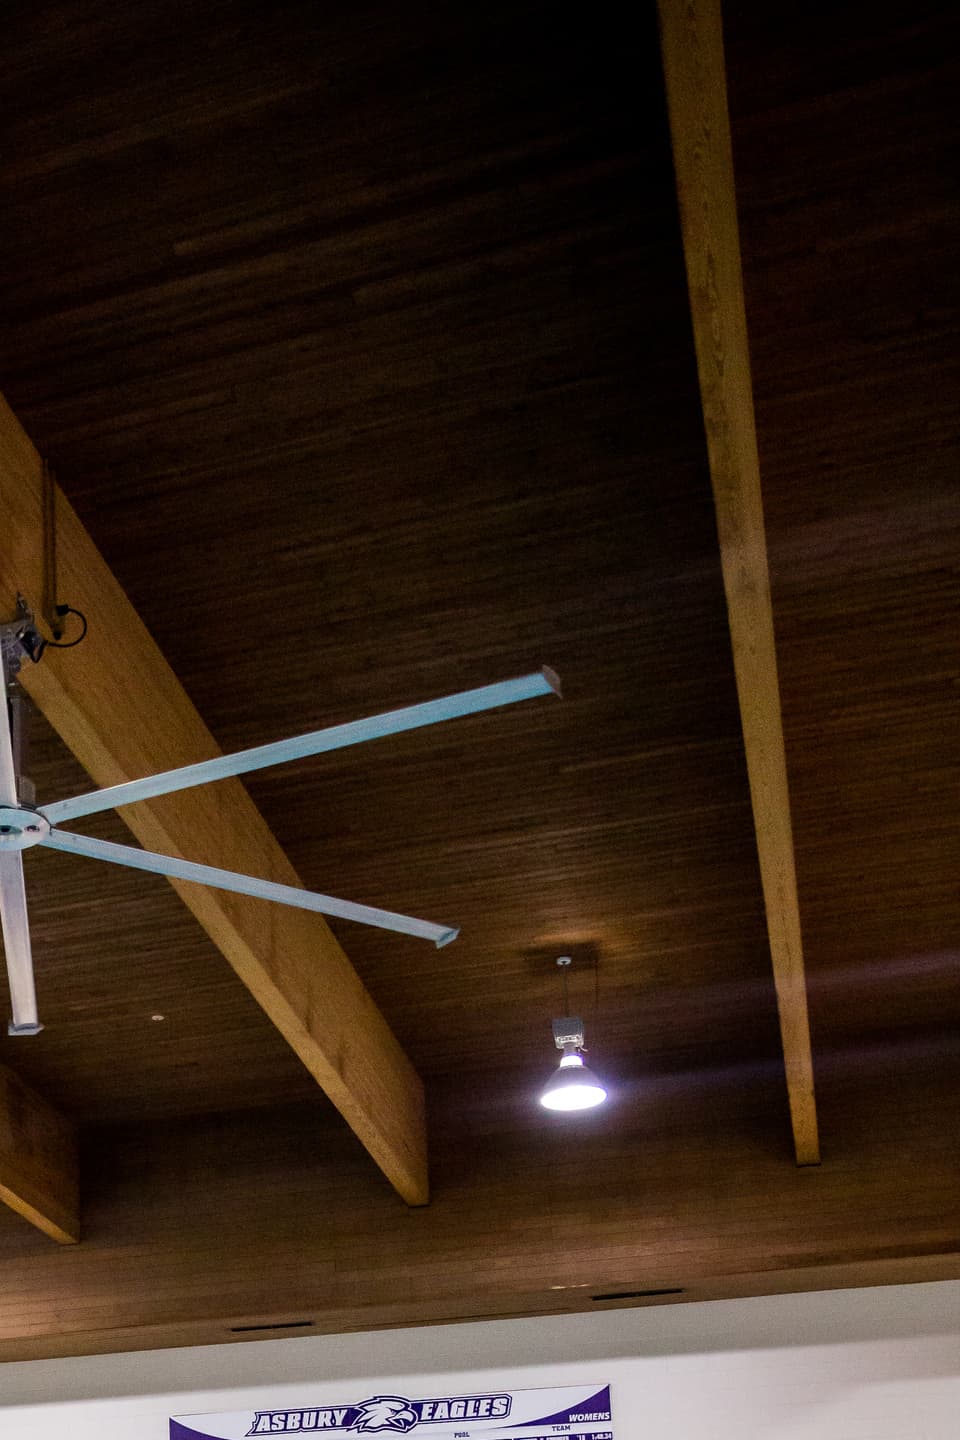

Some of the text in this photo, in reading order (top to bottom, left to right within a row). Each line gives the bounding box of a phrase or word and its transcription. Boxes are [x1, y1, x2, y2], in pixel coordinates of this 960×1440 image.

[256, 1396, 509, 1432] ASBURY EAGLES
[568, 1411, 610, 1422] WOMENS
